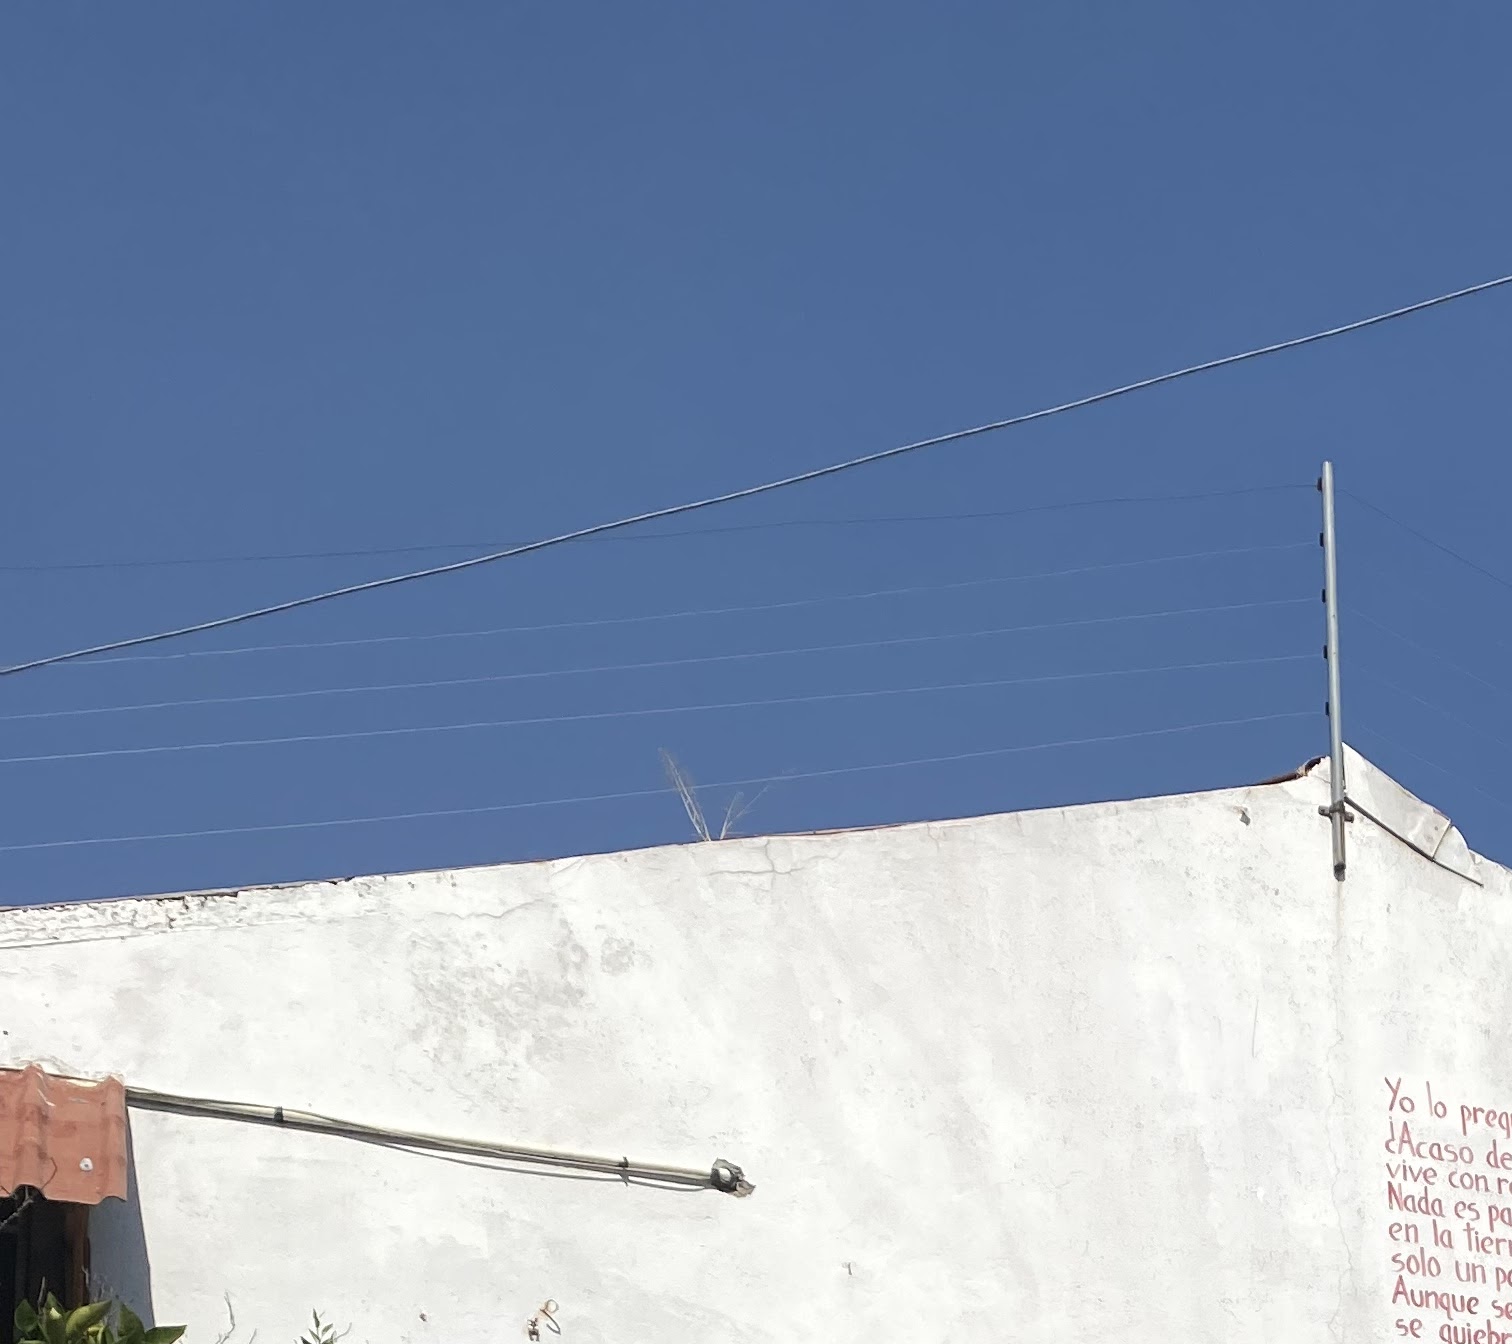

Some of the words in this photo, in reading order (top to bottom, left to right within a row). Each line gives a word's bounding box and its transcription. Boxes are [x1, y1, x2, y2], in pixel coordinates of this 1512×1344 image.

[1384, 1077, 1415, 1114] Yo
[1426, 1081, 1447, 1118] lo
[1486, 1139, 1512, 1171] de
[1386, 1160, 1437, 1186] vive
[1448, 1169, 1490, 1193] con
[1387, 1180, 1446, 1218] Nada
[1454, 1200, 1480, 1221] es
[1388, 1222, 1419, 1245] en
[1432, 1219, 1454, 1249] la
[1391, 1247, 1441, 1278] solo
[1454, 1258, 1487, 1285] un
[1391, 1275, 1479, 1320] Aunque
[1395, 1317, 1423, 1339] se
